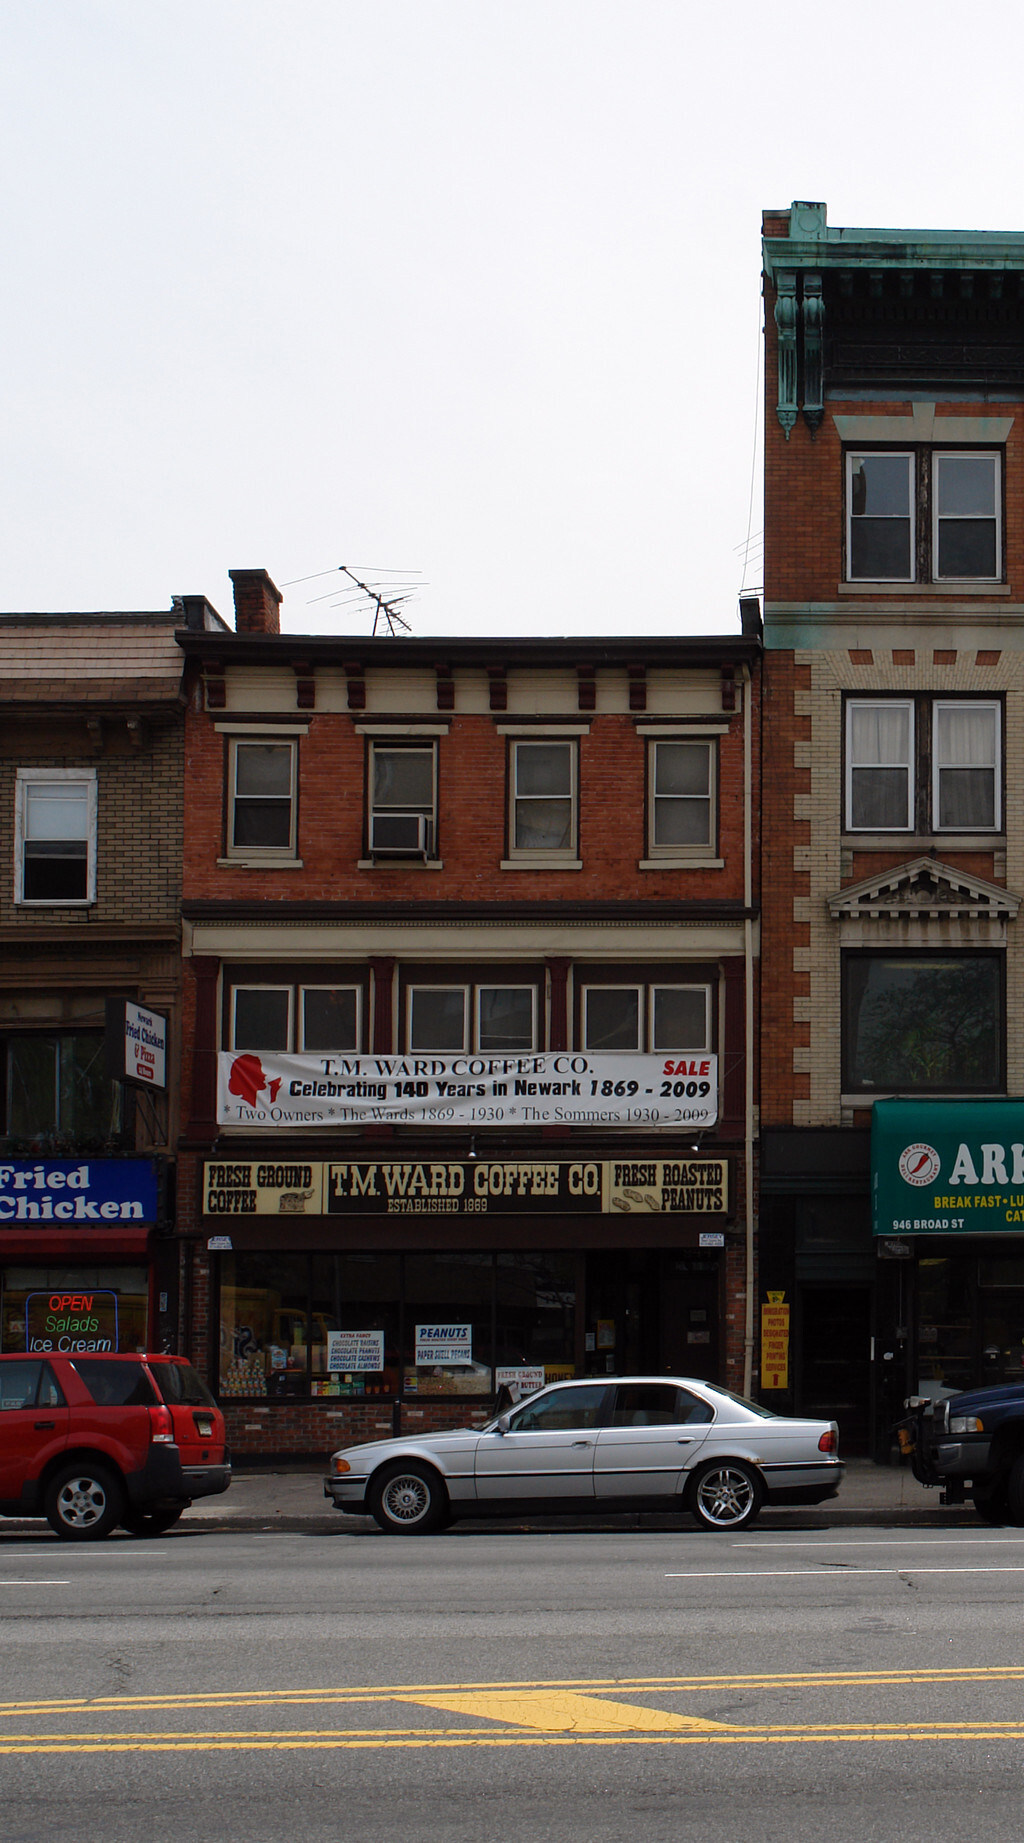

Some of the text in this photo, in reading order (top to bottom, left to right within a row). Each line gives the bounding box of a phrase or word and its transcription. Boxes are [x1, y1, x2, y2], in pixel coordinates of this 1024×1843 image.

[126, 1020, 164, 1050] Fried Chicken
[140, 1046, 155, 1064] Pizza
[320, 1056, 710, 1076] T.M. WARD COFFEE CO. SALE
[289, 1080, 387, 1100] Celebrating
[394, 1081, 429, 1097] 140
[436, 1081, 486, 1097] Years
[492, 1080, 508, 1096] in
[514, 1079, 582, 1096] Newark
[590, 1080, 639, 1096] 1869
[660, 1081, 710, 1098] 2009
[236, 1106, 266, 1120] Two
[270, 1107, 324, 1122] Owners
[340, 1107, 366, 1120] The
[370, 1107, 414, 1120] Wards
[422, 1107, 454, 1120] 1869
[470, 1106, 504, 1121] 1930
[521, 1106, 550, 1120] The
[554, 1106, 620, 1122] Sommers
[626, 1108, 660, 1122] 1930
[674, 1108, 708, 1122] 2009
[0, 1166, 90, 1188] Fried
[208, 1165, 312, 1188] FRESH GROUND
[331, 1164, 601, 1196] T.M. WARD COFFEE CO.
[614, 1163, 722, 1186] FRESH ROASTED
[0, 1196, 144, 1219] Chicken
[208, 1190, 257, 1213] COFFEE
[388, 1198, 488, 1212] ESTABLISHED 1869
[662, 1188, 723, 1211] PEANUTS
[934, 1196, 972, 1208] BREAK
[974, 1195, 1002, 1208] FAST
[892, 1218, 964, 1230] 946 BROAD ST
[48, 1295, 94, 1312] OPEN
[44, 1315, 100, 1332] Salads
[768, 1318, 784, 1326] PHOTOS
[420, 1328, 468, 1338] PEANUTS
[30, 1336, 112, 1352] Ice Cream
[358, 1354, 380, 1362] CASHEWS
[418, 1350, 434, 1360] PAPER
